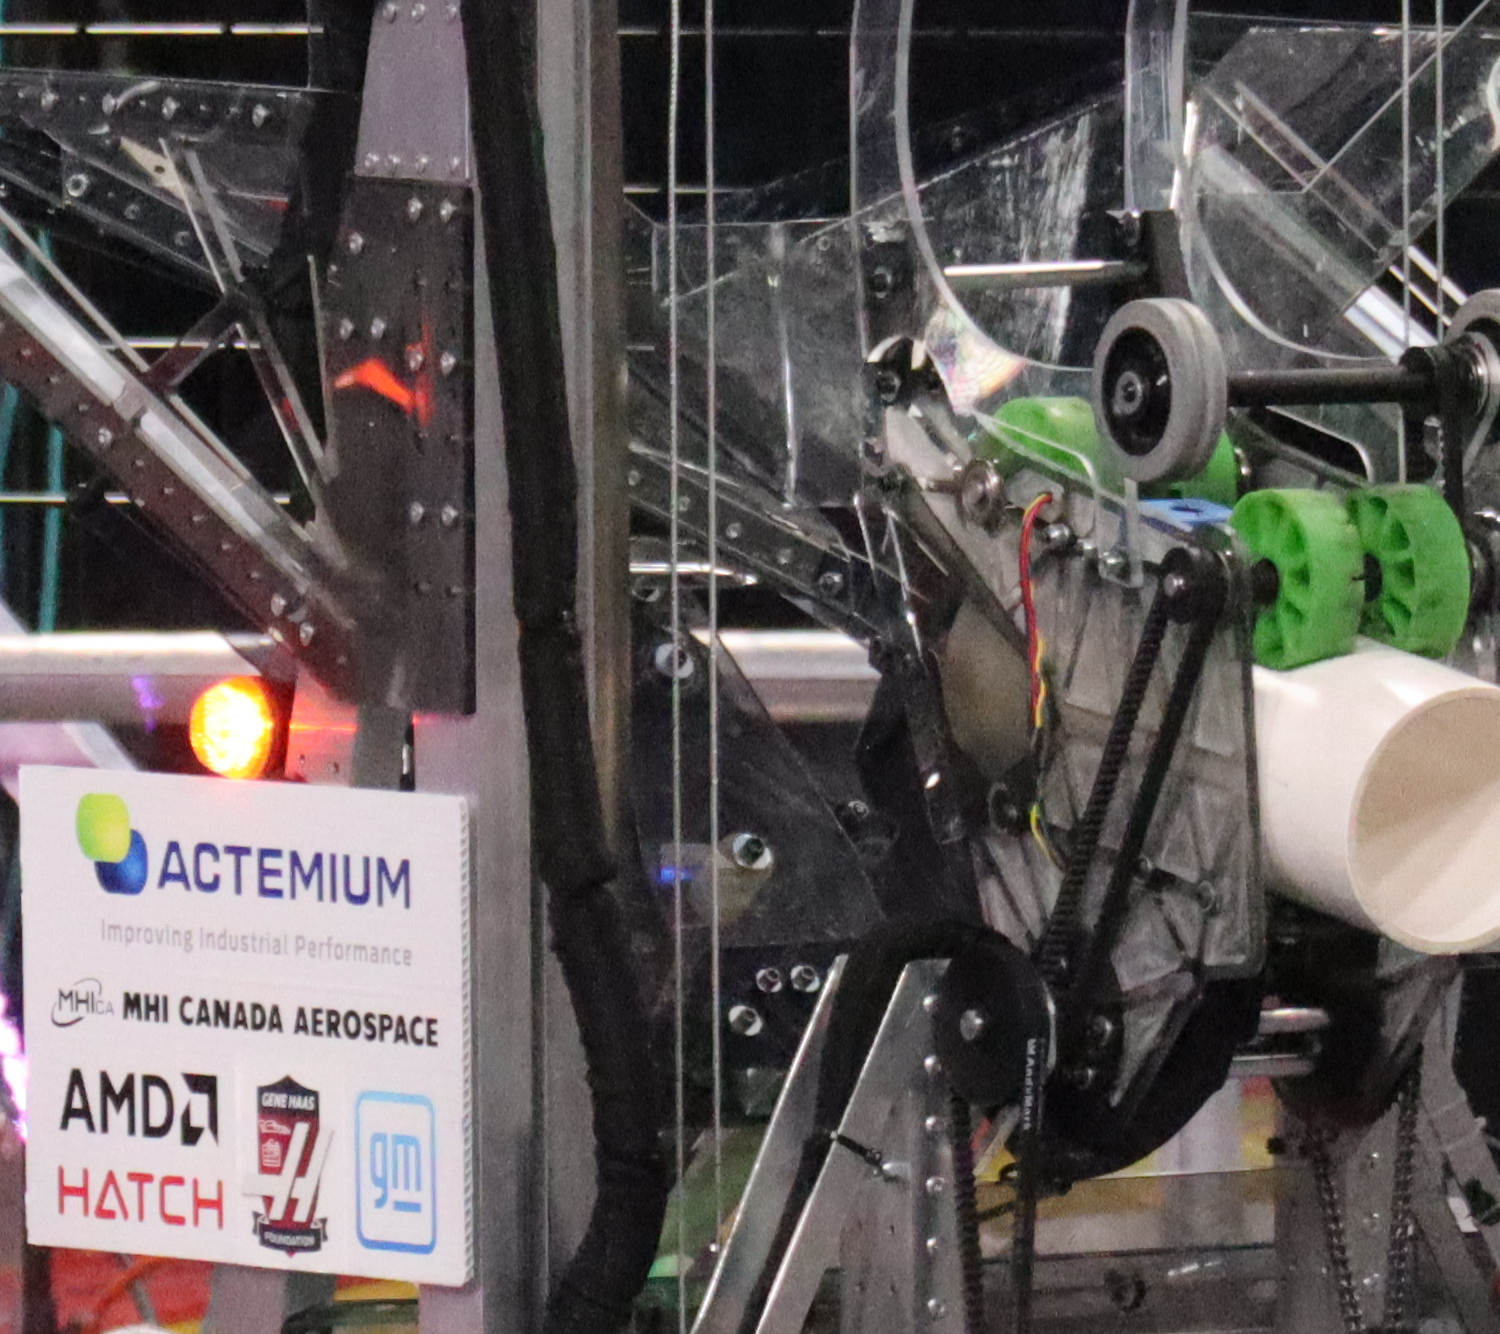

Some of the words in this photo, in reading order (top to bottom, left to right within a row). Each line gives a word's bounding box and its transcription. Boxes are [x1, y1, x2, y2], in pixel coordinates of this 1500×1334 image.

[157, 840, 411, 909] ACTEMIUM
[101, 918, 194, 953] Improving
[199, 926, 288, 956] Industrial
[294, 934, 413, 966] Performance
[122, 991, 169, 1023] MHI
[178, 995, 284, 1034] CANADA
[293, 1005, 439, 1047] AEROSPACE
[59, 1068, 176, 1140] AMD
[261, 1091, 288, 1109] GENE
[288, 1094, 315, 1111] HAAS
[57, 1165, 224, 1230] HATCH
[264, 1230, 316, 1248] FOUNDATION
